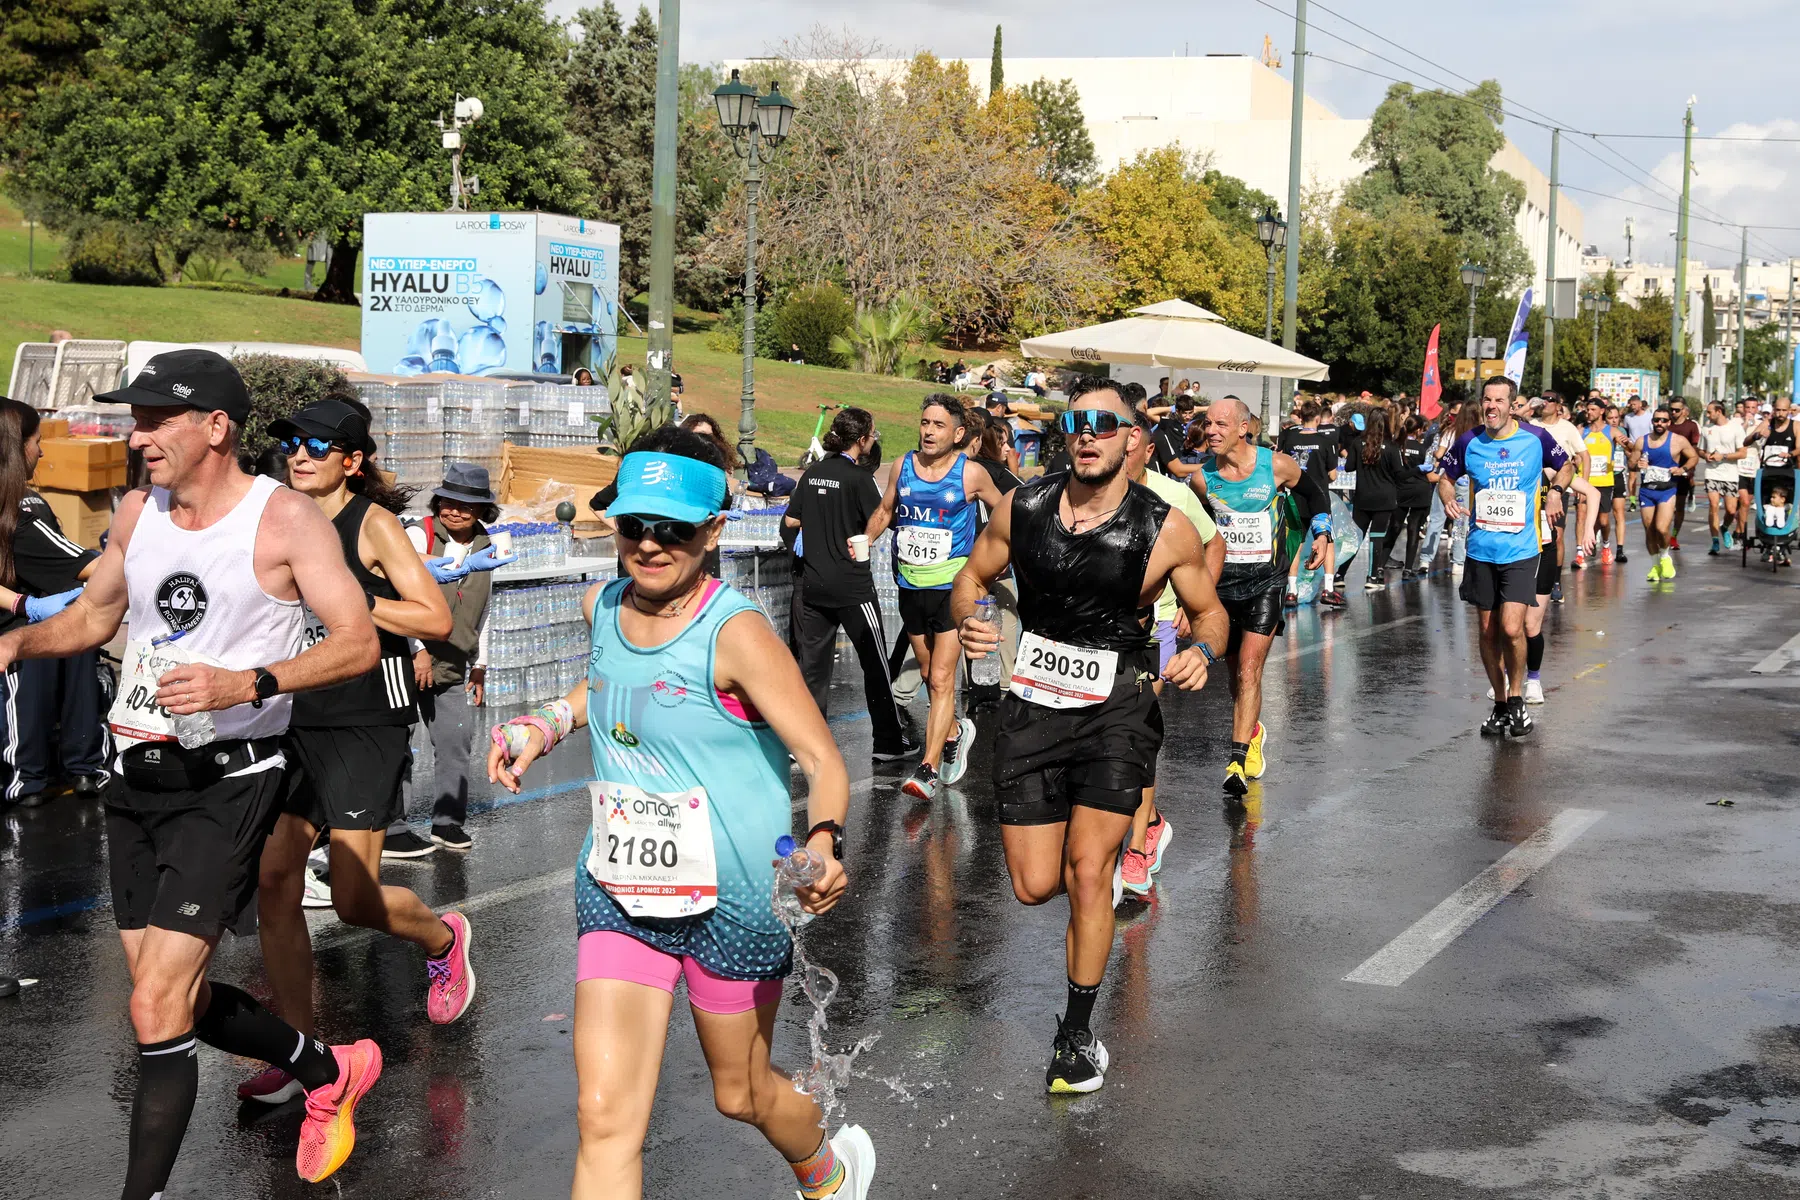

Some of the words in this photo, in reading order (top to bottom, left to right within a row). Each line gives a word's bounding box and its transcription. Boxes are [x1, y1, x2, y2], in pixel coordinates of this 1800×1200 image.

[370, 259, 395, 270] ΝΕΟ
[398, 259, 475, 271] ΥΠΕΡ-ΕΝΕΡΓΟ
[550, 256, 591, 278] HYALU
[593, 261, 607, 280] B5
[371, 272, 449, 293] HYALU
[456, 273, 484, 294] B5
[370, 296, 392, 311] 2X
[395, 296, 459, 304] ΥΑΛΟΥΡΟΝΙΚΟ
[394, 304, 412, 312] ΣΤΟ
[1483, 459, 1525, 469] Alzheimer's
[1490, 467, 1518, 476] Society
[1488, 476, 1520, 491] DAVE
[1242, 493, 1269, 502] academy
[1247, 487, 1271, 495] running
[1486, 505, 1514, 517] 3496
[1222, 531, 1263, 544] 29023
[907, 543, 937, 560] 7615
[1029, 647, 1100, 681] 29030
[615, 731, 635, 744] Arla
[657, 818, 682, 831] allwyn
[608, 833, 678, 868] 2180
[636, 885, 661, 894] ΔΡΟΜΟΣ
[661, 885, 677, 895] 2025
